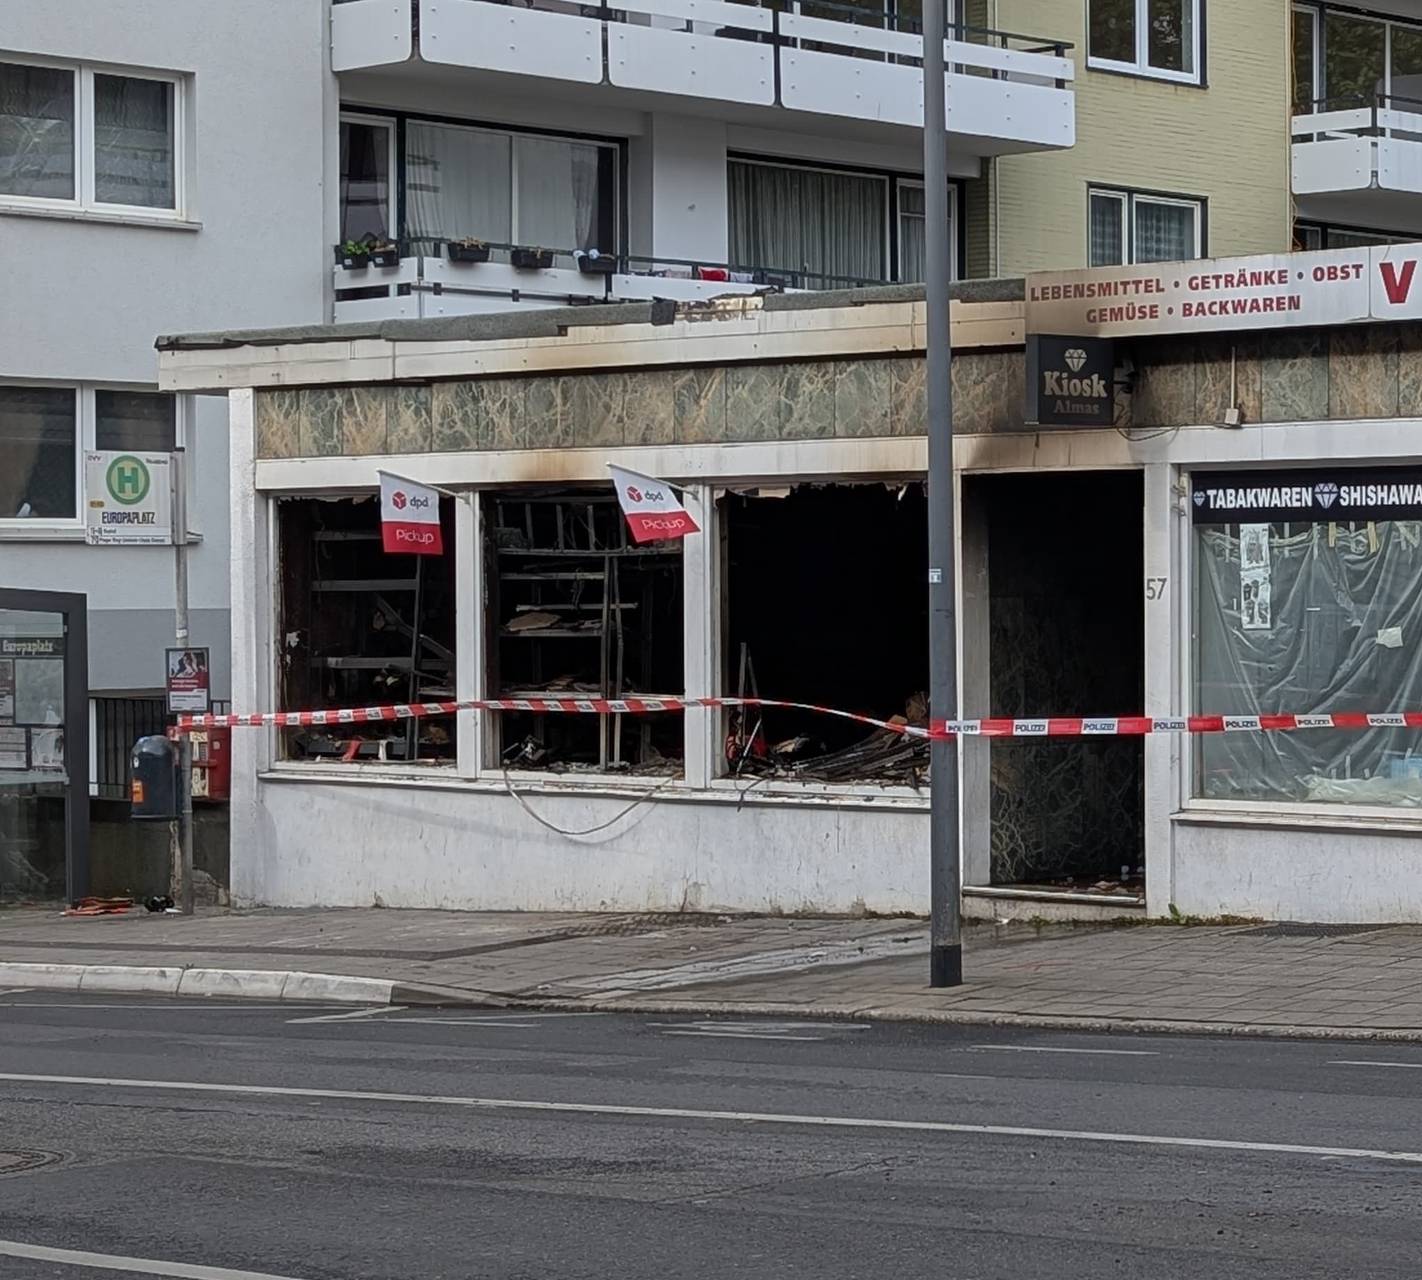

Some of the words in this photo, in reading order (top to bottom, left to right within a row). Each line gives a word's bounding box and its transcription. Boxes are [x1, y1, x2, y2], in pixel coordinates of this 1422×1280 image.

[1030, 277, 1165, 301] LEBENSMITTEL
[1187, 268, 1289, 292] GETRÄNKE
[1312, 263, 1364, 282] OBST
[1085, 303, 1160, 325] GEMÜSE
[1181, 295, 1301, 317] BACKWAREN
[1043, 370, 1108, 398] Kiosk
[1053, 399, 1101, 414] Almas
[410, 496, 429, 508] dpd
[644, 490, 664, 503] dpd
[1206, 487, 1313, 509] TABAKWAREN
[101, 511, 156, 525] EUROPAPLATZ
[641, 518, 686, 531] Pickup
[396, 529, 434, 545] Pickup
[1145, 577, 1168, 600] 57
[1015, 724, 1046, 732] POLIZEI
[1083, 723, 1115, 731] POLIZEI
[1154, 722, 1186, 730] POLIZEI
[1225, 720, 1258, 728] POLIZEI
[1298, 718, 1331, 726] POLIZEI
